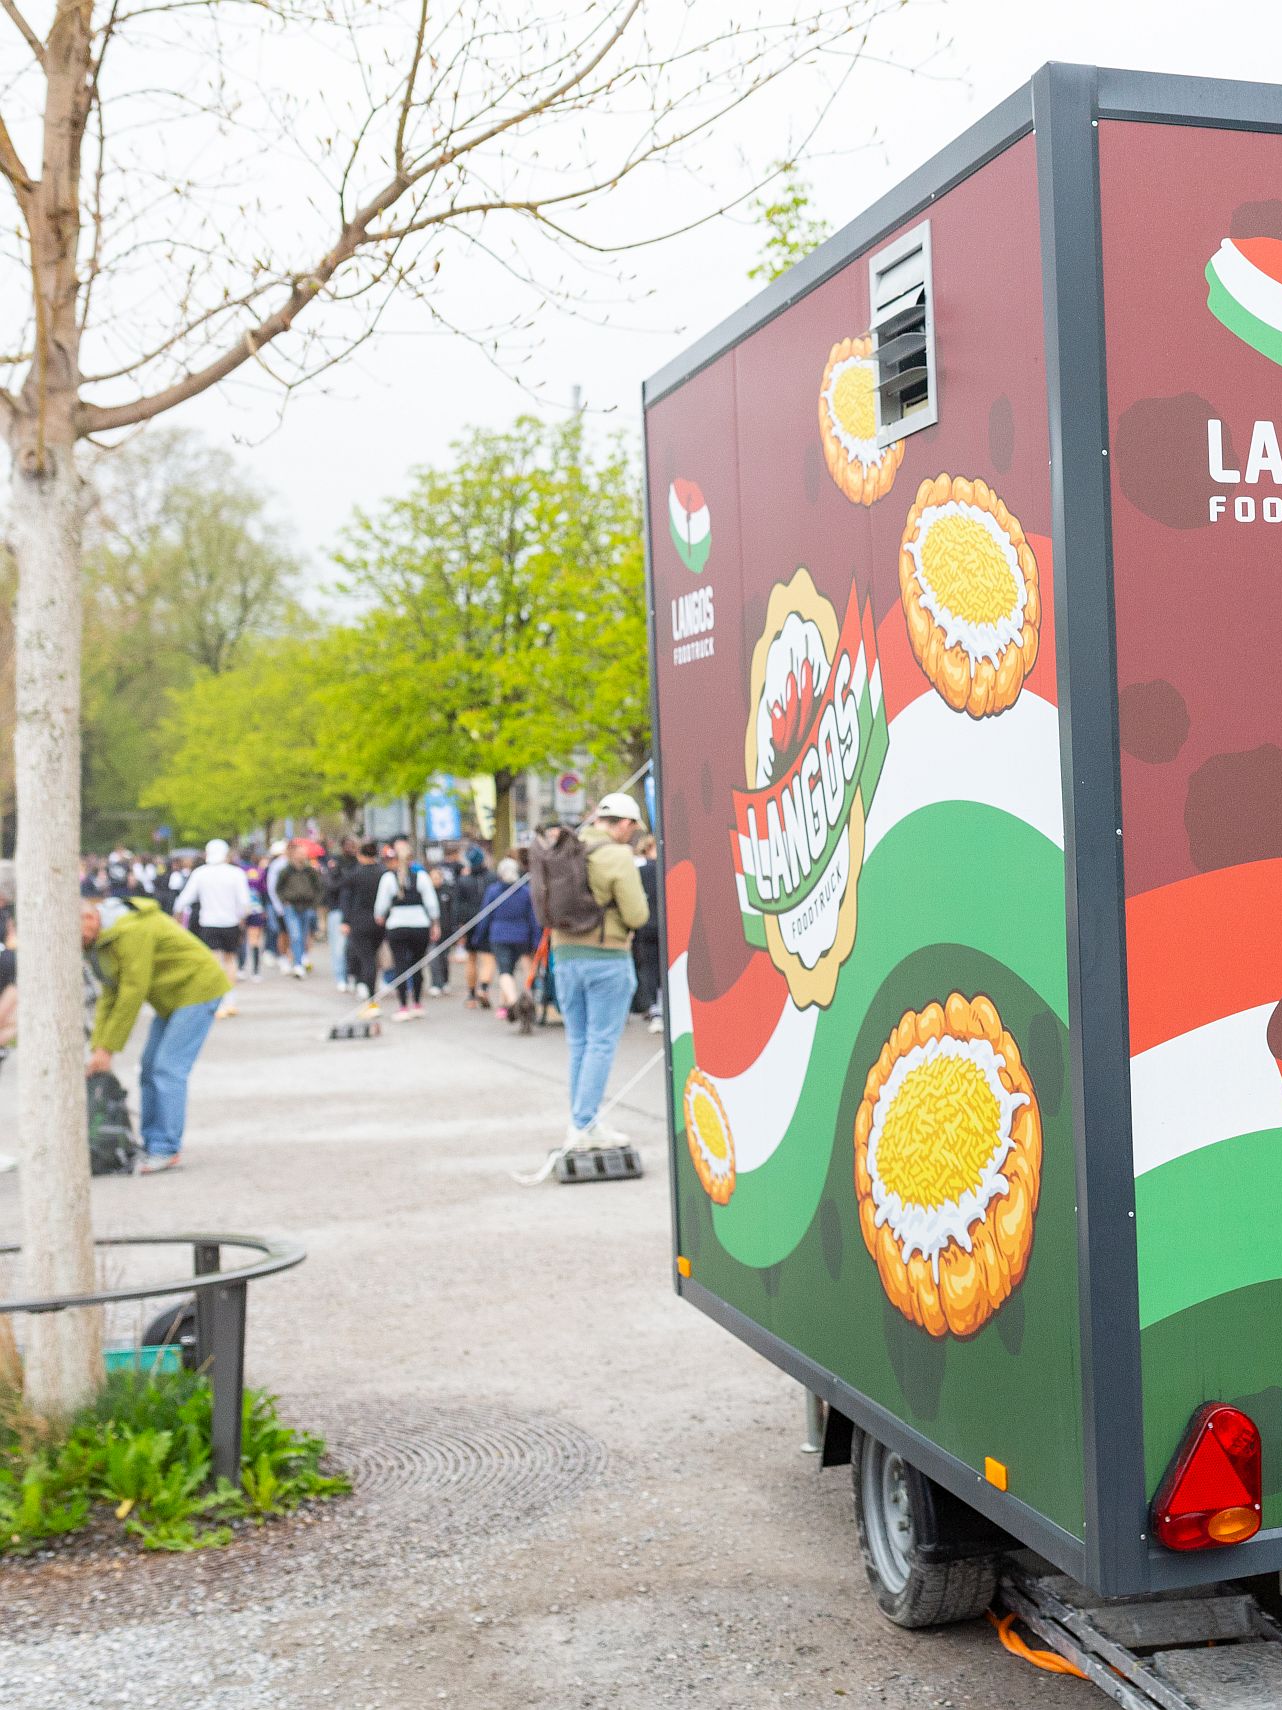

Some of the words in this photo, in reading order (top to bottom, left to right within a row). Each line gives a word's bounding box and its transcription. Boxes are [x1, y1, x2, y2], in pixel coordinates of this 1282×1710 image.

[671, 585, 715, 641] LANGOS
[673, 636, 715, 666] FOODTRUCK
[746, 651, 860, 902] LANGOS
[791, 860, 842, 940] FOODTRUCK
